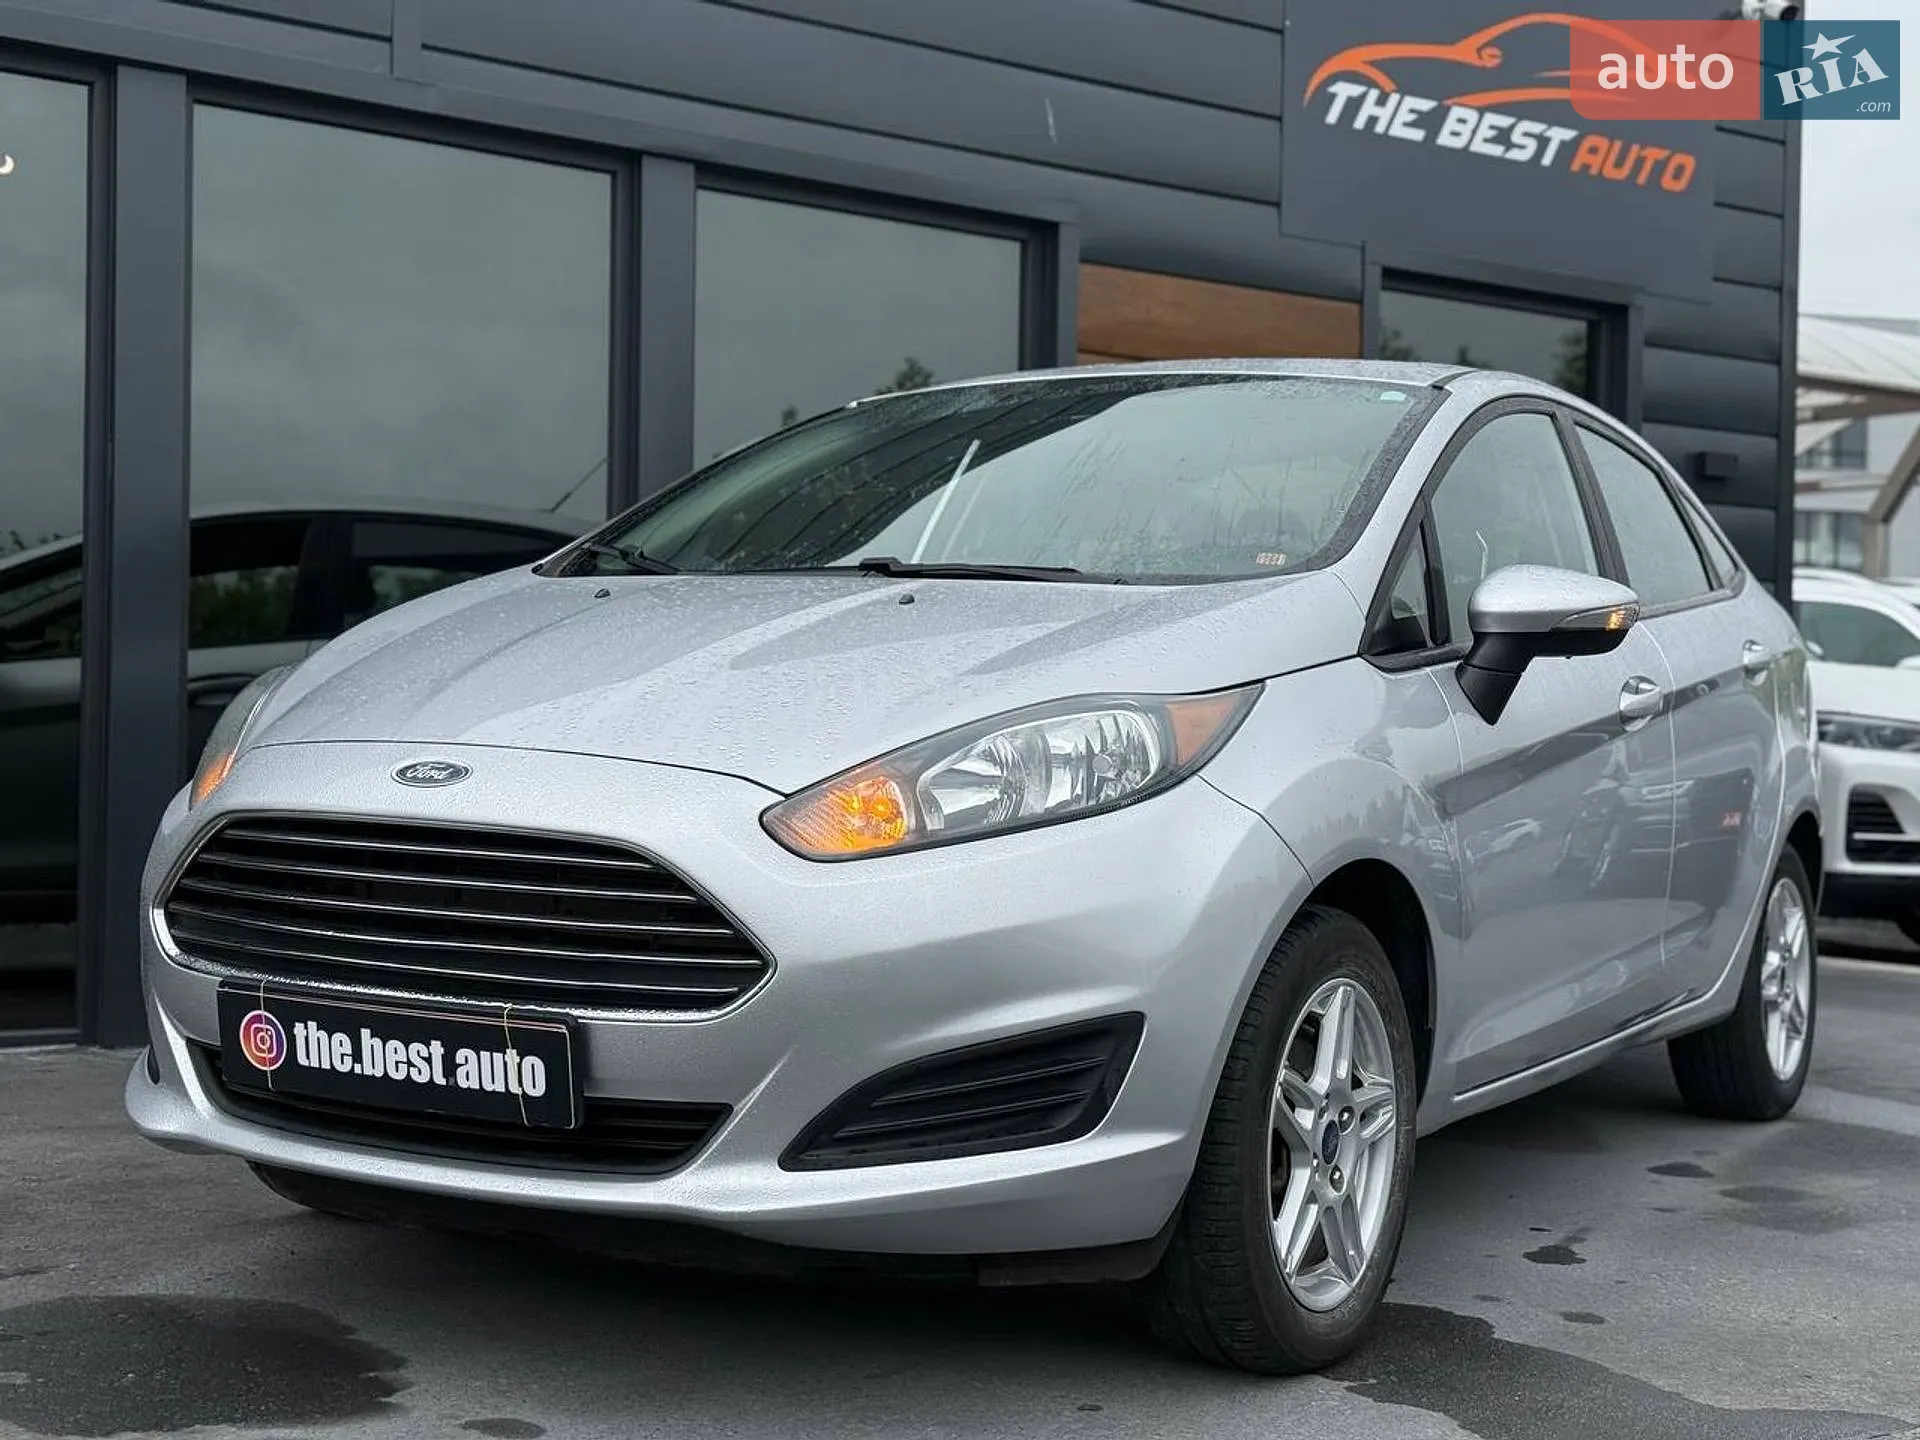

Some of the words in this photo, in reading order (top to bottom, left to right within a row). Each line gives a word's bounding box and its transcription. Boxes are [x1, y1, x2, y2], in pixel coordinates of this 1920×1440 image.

[1324, 81, 1439, 141] THE
[1436, 104, 1578, 167] BEST
[1571, 134, 1697, 193] AUTO
[406, 763, 454, 779] Ford
[455, 1047, 547, 1098] auto
